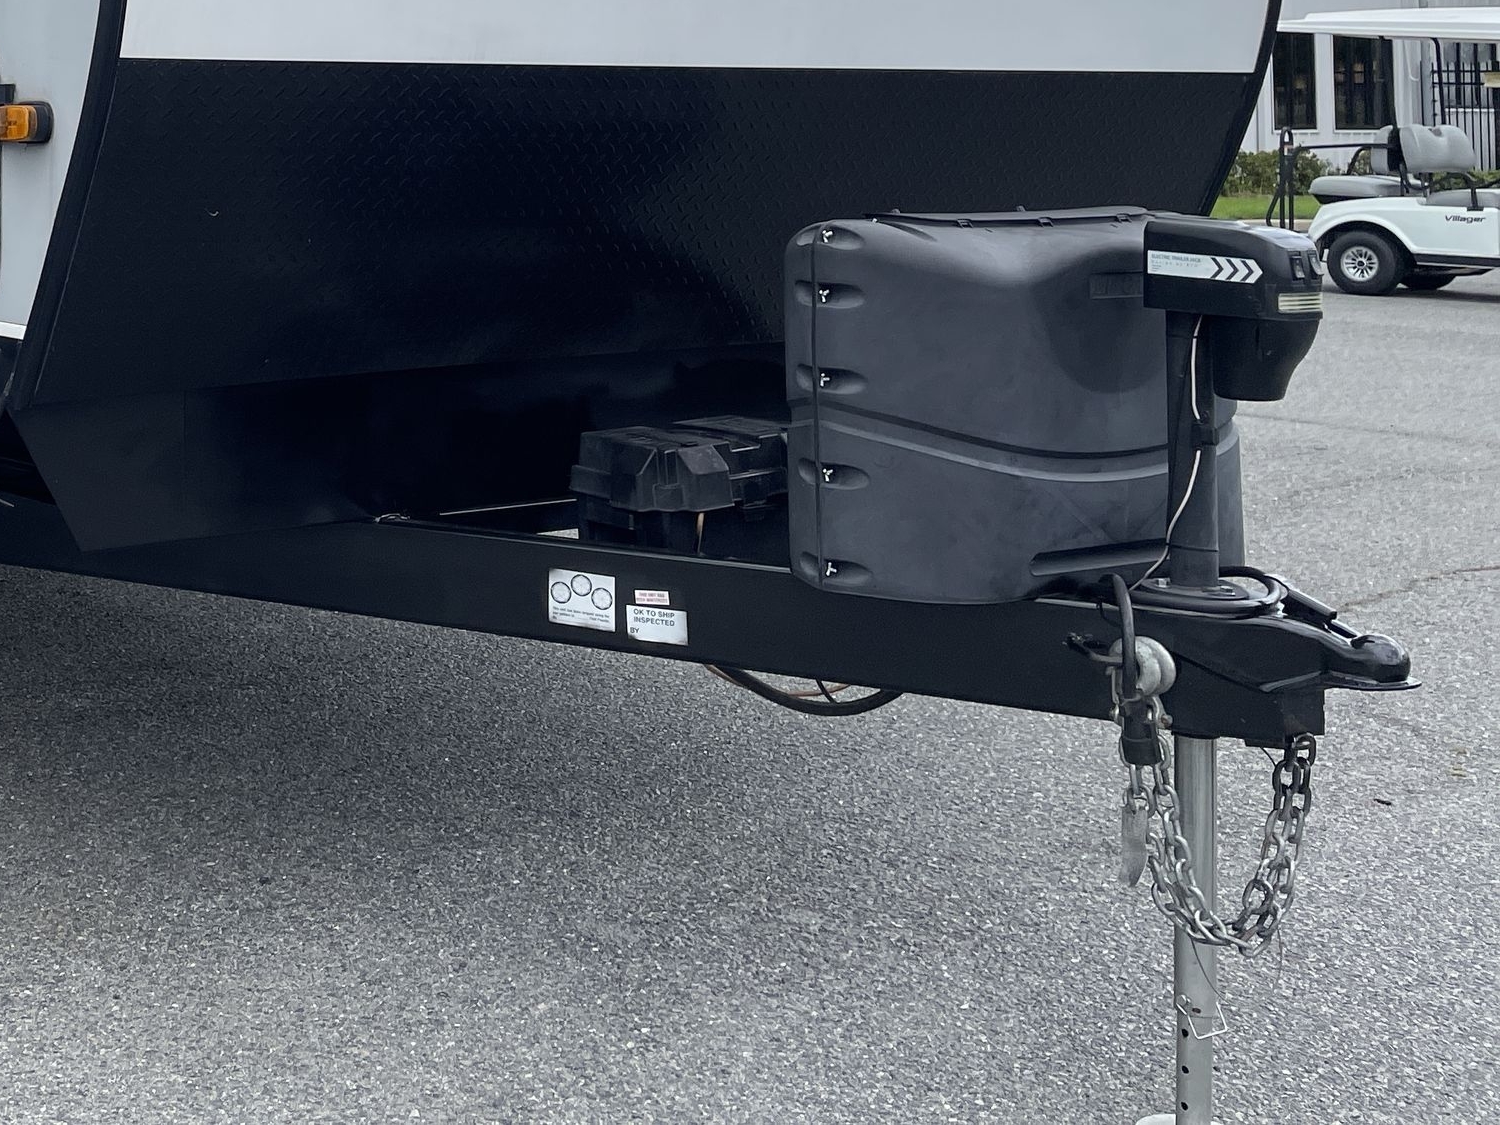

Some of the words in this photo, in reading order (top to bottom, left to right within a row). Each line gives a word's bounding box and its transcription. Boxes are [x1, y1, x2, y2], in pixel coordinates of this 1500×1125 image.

[1445, 215, 1486, 224] Villager
[633, 608, 644, 616] OK
[646, 609, 656, 617] TO
[658, 610, 675, 618] SHIP
[633, 616, 675, 626] INSPECTED
[630, 626, 639, 634] BY
